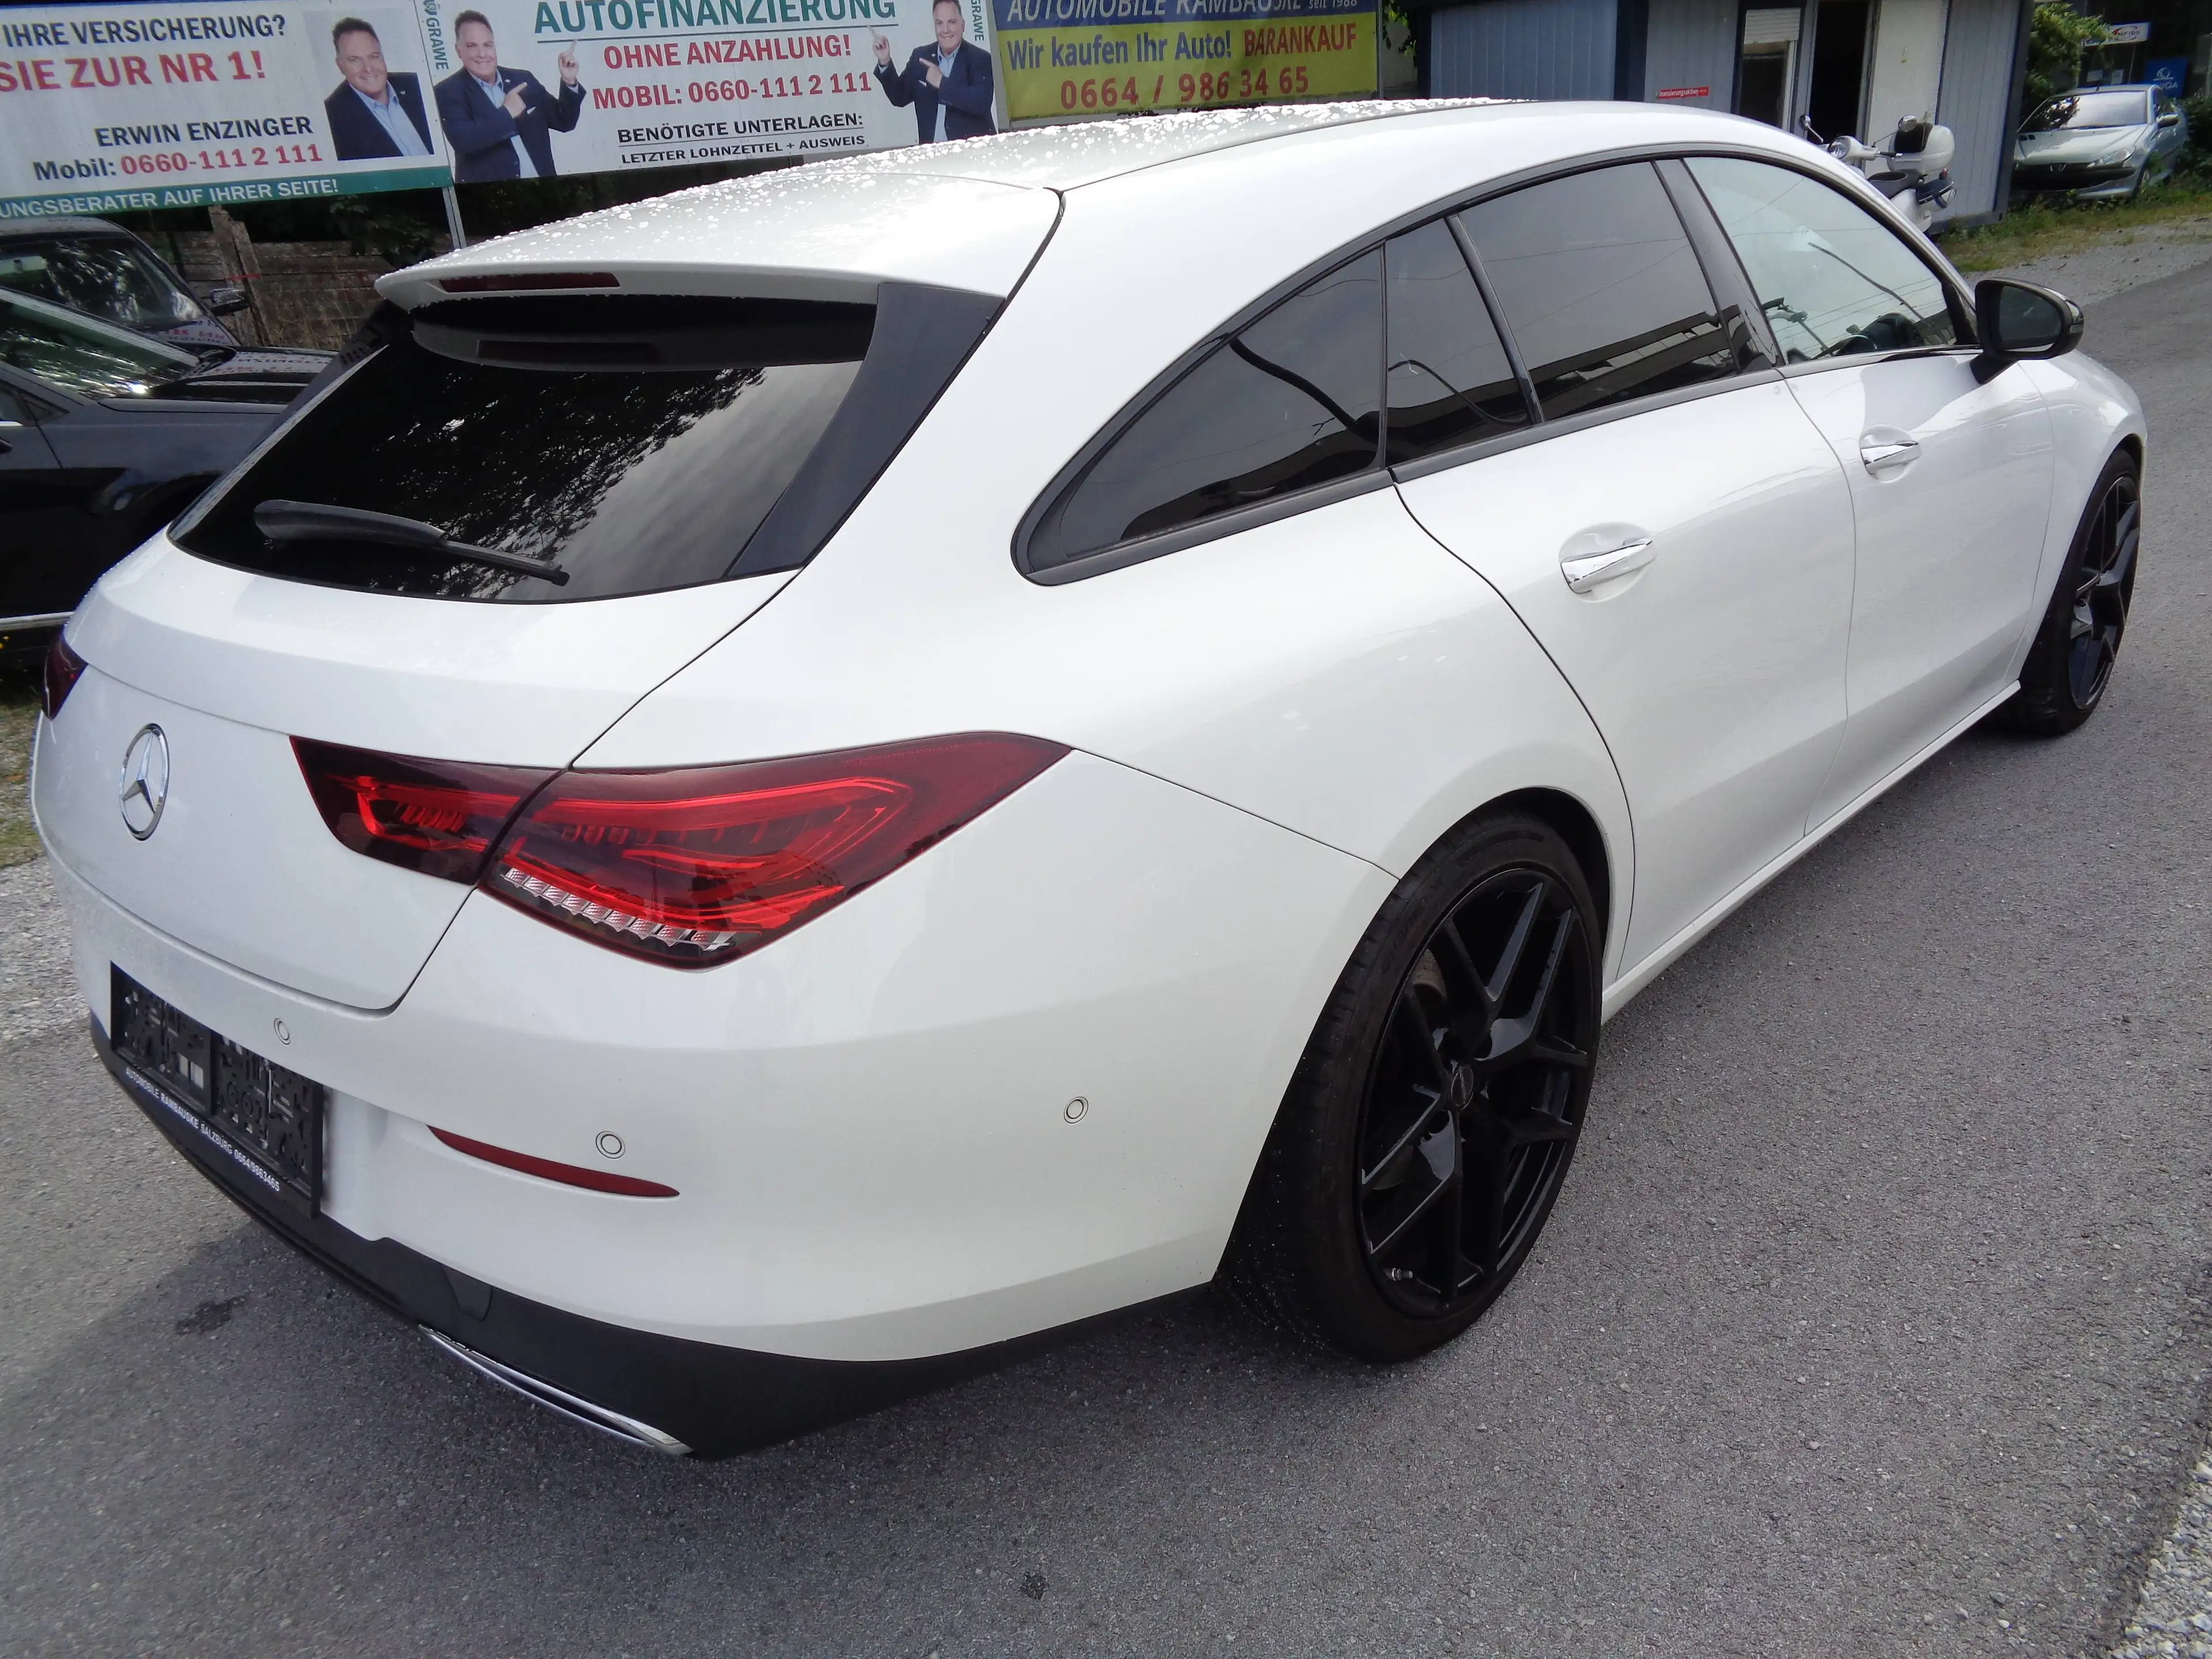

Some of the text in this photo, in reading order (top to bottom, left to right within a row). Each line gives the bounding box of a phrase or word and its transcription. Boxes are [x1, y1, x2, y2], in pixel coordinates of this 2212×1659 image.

[2, 14, 286, 47] IHRE VERSICHERUNG?
[535, 0, 896, 34] AUTOFINANZIERUNG
[425, 18, 449, 70] GRAWE
[604, 35, 851, 69] OHNE ANZAHLUNG!
[1007, 22, 1357, 70] Wir kaufen Ihr Auto! BARANKAUF
[0, 50, 266, 93] SIE ZUR NR 1!
[1060, 66, 1309, 110] 0664 / 986 34 65
[593, 84, 683, 109] MOBIL:
[688, 75, 804, 104] 0660-111
[830, 71, 872, 93] 111
[94, 115, 313, 147] ERWIN ENZINGER
[617, 112, 863, 143] BENÖTIGTE UNTERLAGEN:
[33, 157, 117, 181] Mobil:
[120, 147, 247, 175] 0660-111
[275, 143, 323, 165] 111
[621, 149, 685, 164] LETZTER
[691, 142, 783, 159] LOHNZETTEL
[799, 135, 865, 150] AUSWEIS
[0, 179, 339, 219] UNGSBERATER AUF IHRER SEITE!
[200, 1123, 233, 1154] SALZBURG
